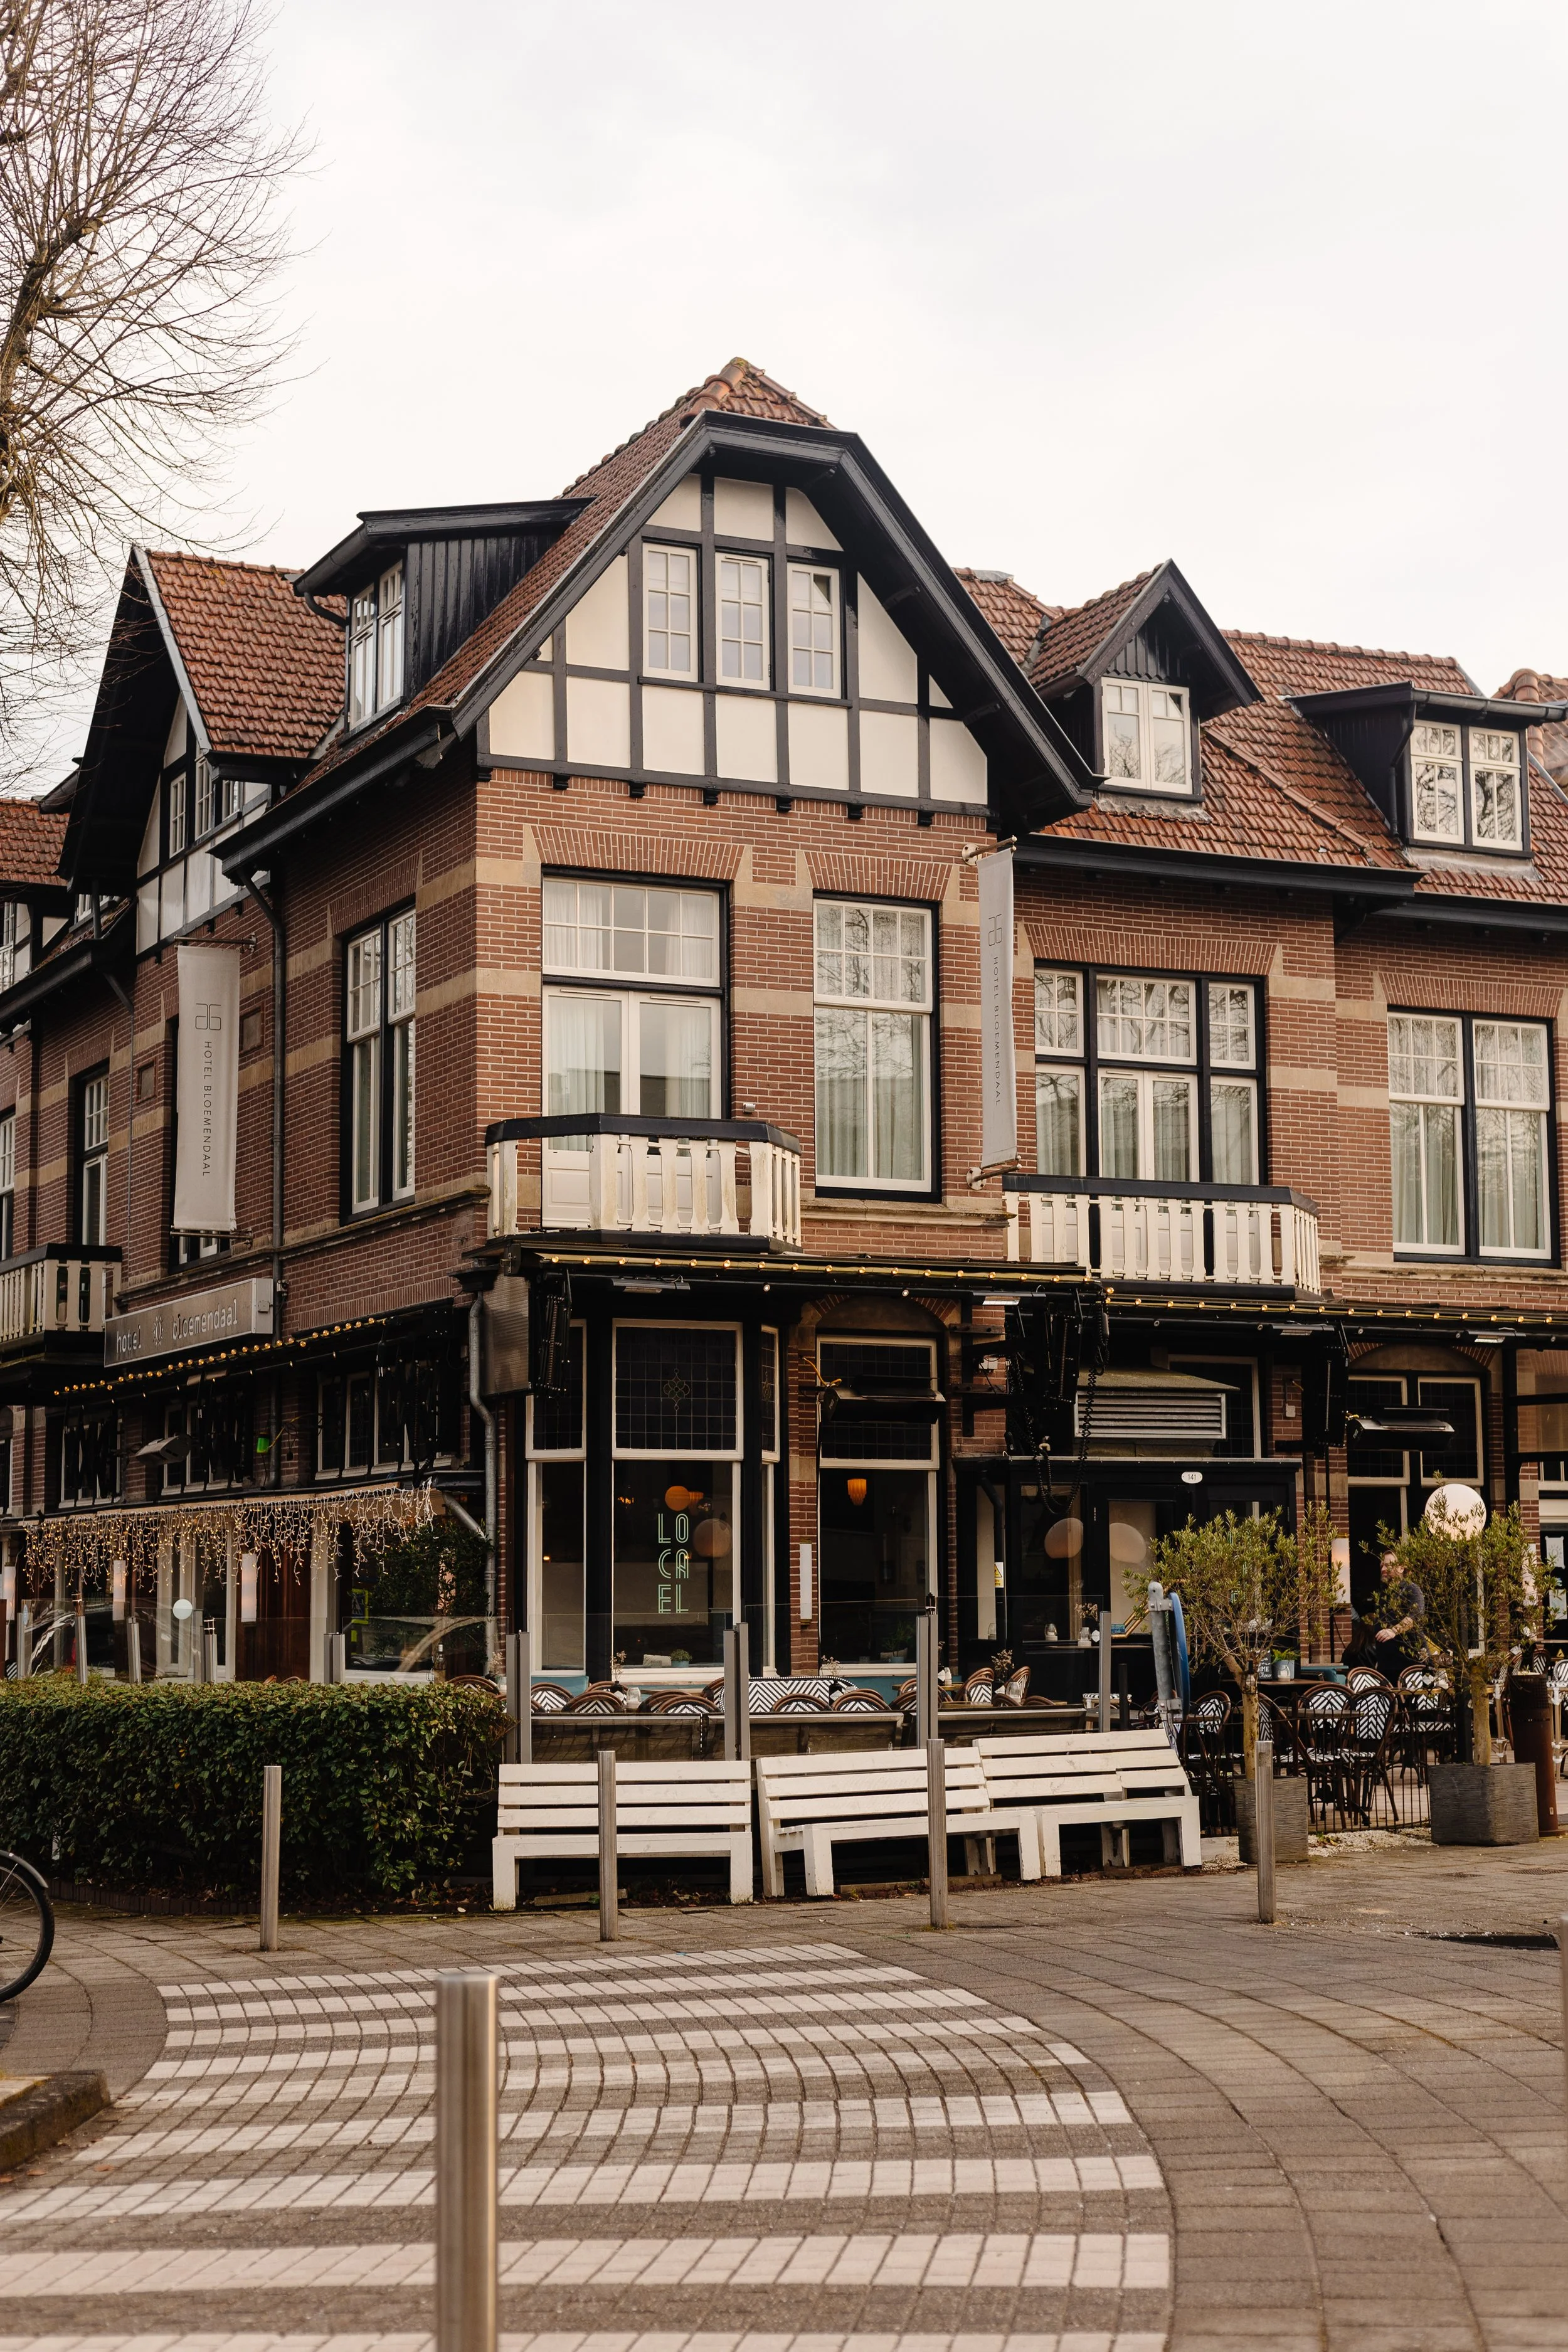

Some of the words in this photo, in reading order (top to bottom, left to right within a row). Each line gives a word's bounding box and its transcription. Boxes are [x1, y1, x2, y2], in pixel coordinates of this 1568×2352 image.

[204, 1041, 212, 1079] HOTEL
[202, 1086, 212, 1176] BLOEMENDAAL
[116, 1325, 142, 1353] hotel
[172, 1298, 238, 1340] bloemendaal
